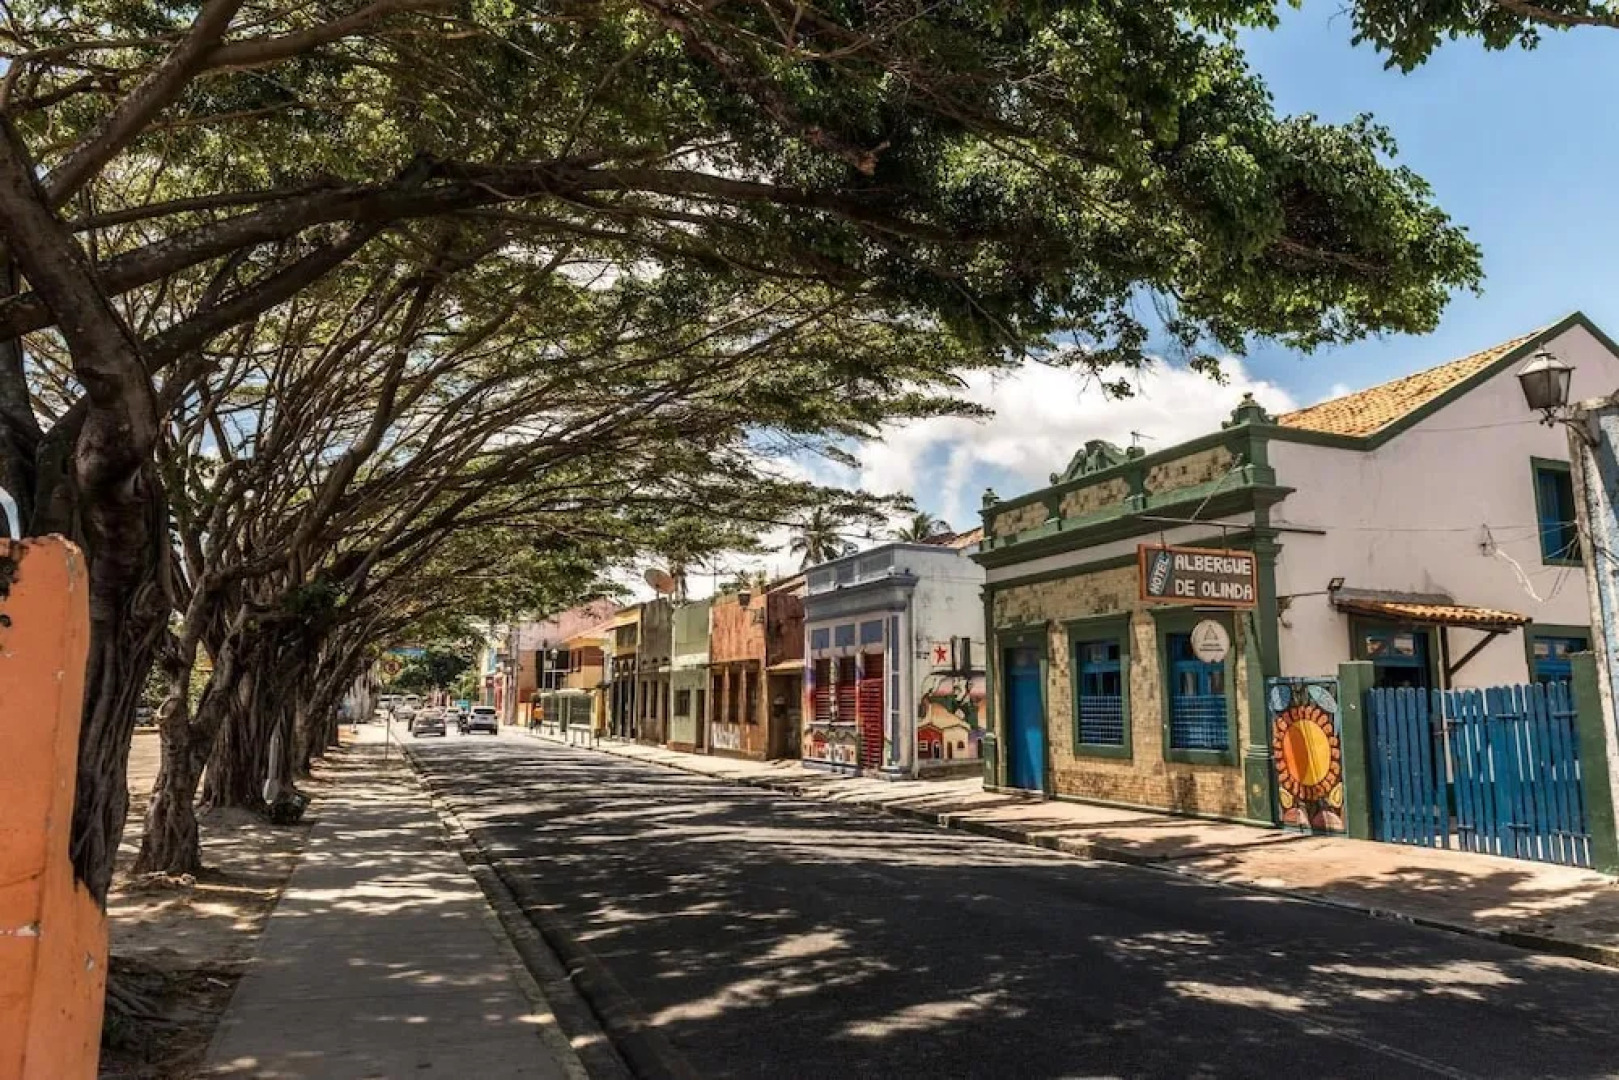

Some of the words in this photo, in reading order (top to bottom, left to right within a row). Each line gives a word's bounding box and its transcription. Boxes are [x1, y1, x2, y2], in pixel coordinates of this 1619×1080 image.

[1149, 557, 1170, 594] HOTEL
[1174, 554, 1253, 576] ALBERGUE
[1174, 579, 1196, 597] DE
[1201, 581, 1253, 600] OLINDA
